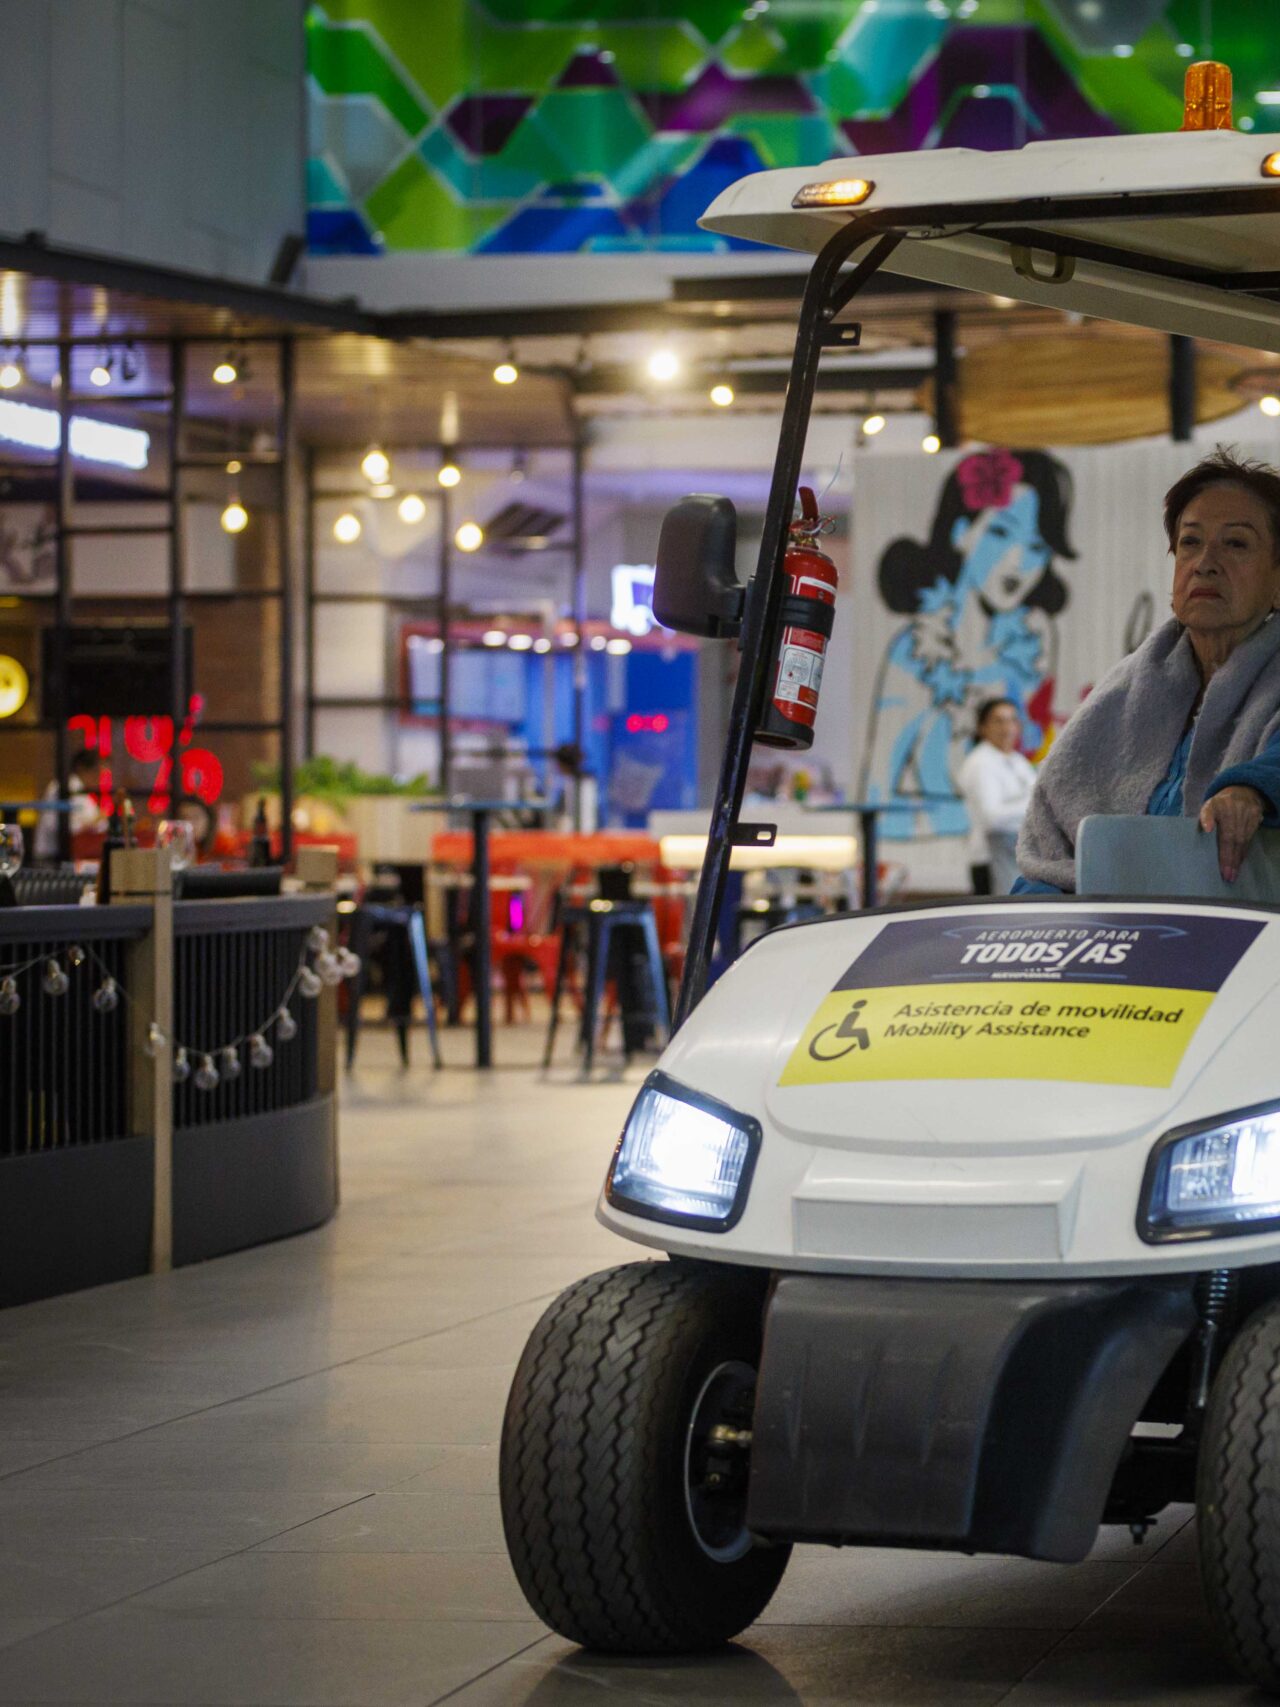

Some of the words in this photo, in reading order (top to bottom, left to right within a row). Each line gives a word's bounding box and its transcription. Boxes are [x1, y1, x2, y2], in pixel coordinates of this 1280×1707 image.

[976, 929, 1088, 942] AEROPUERTO
[1093, 929, 1140, 942] PARA
[960, 939, 1132, 966] TODOS/AS
[893, 1000, 1013, 1018] Asistencia
[1020, 1000, 1050, 1017] de
[1057, 1003, 1184, 1024] movilidad
[883, 1021, 973, 1040] Mobility
[976, 1021, 1091, 1039] Assistance
